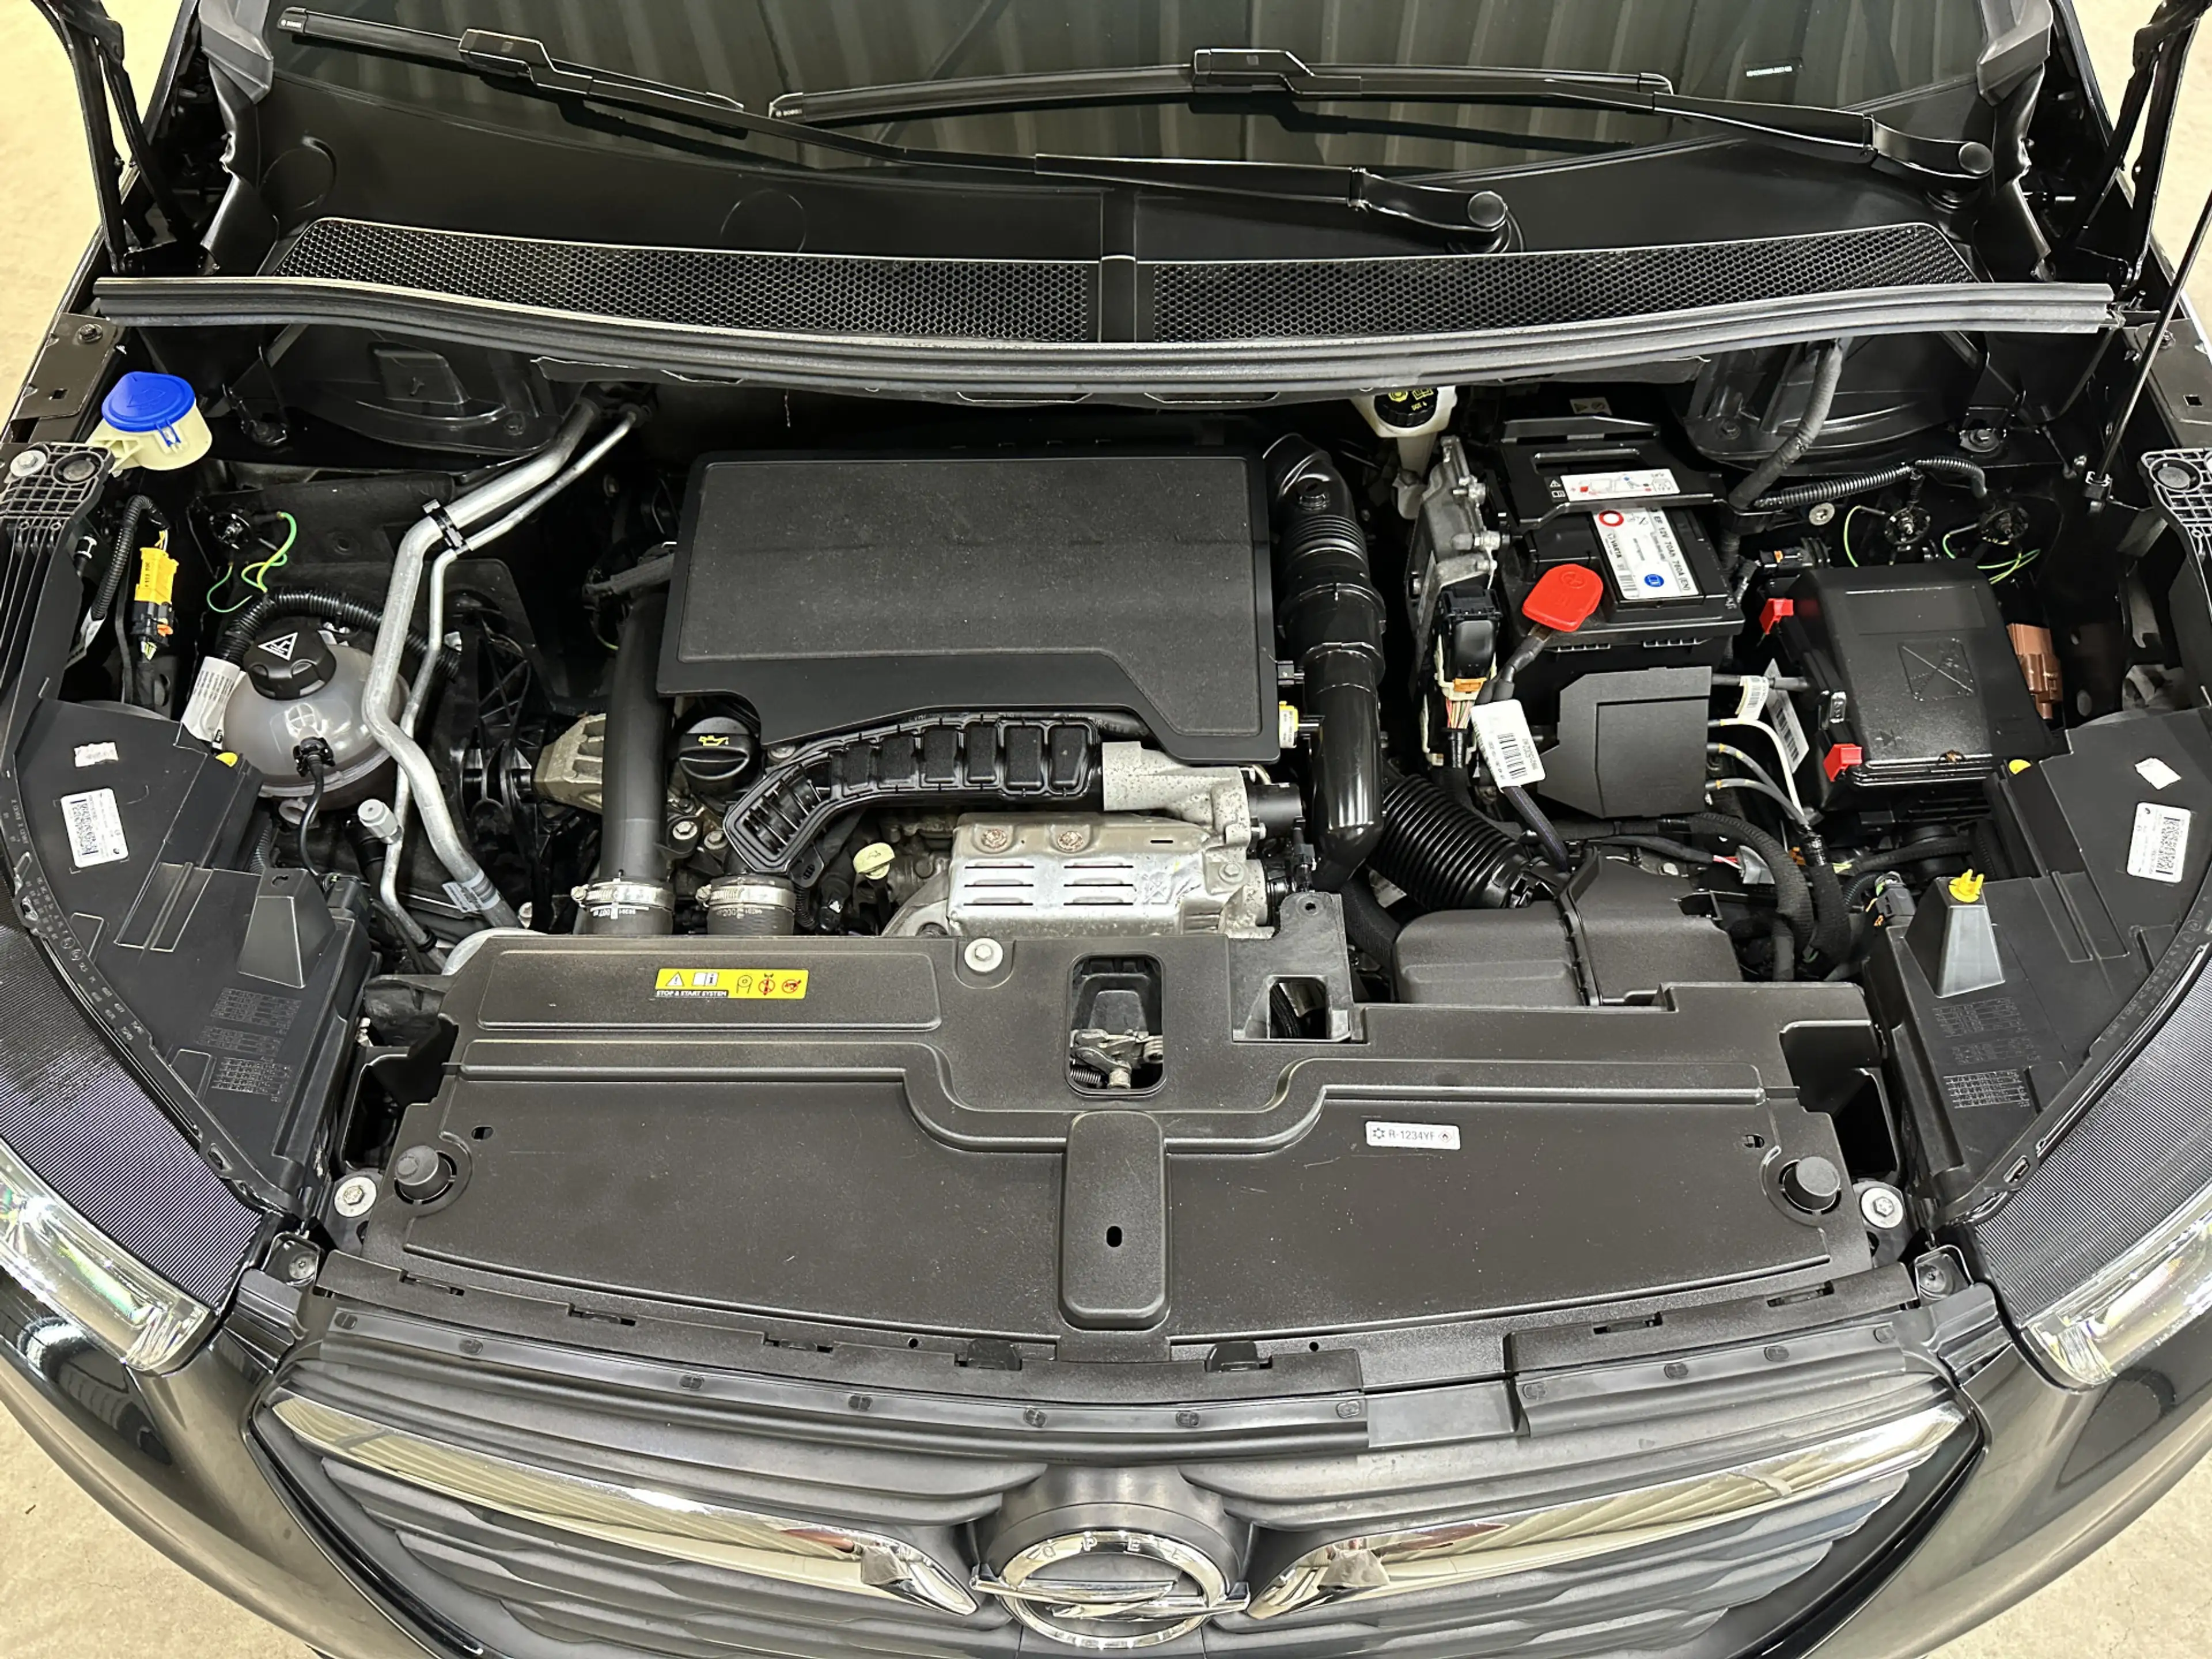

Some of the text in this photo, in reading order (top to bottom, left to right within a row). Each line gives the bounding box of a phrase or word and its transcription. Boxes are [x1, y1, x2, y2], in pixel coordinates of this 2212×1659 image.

[1610, 540, 1622, 559] VARTA
[1659, 527, 1669, 538] 12V
[1665, 541, 1676, 557] 70Ah
[1388, 1129, 1435, 1141] R-1234YF
[1041, 1535, 1181, 1561] OPEL
